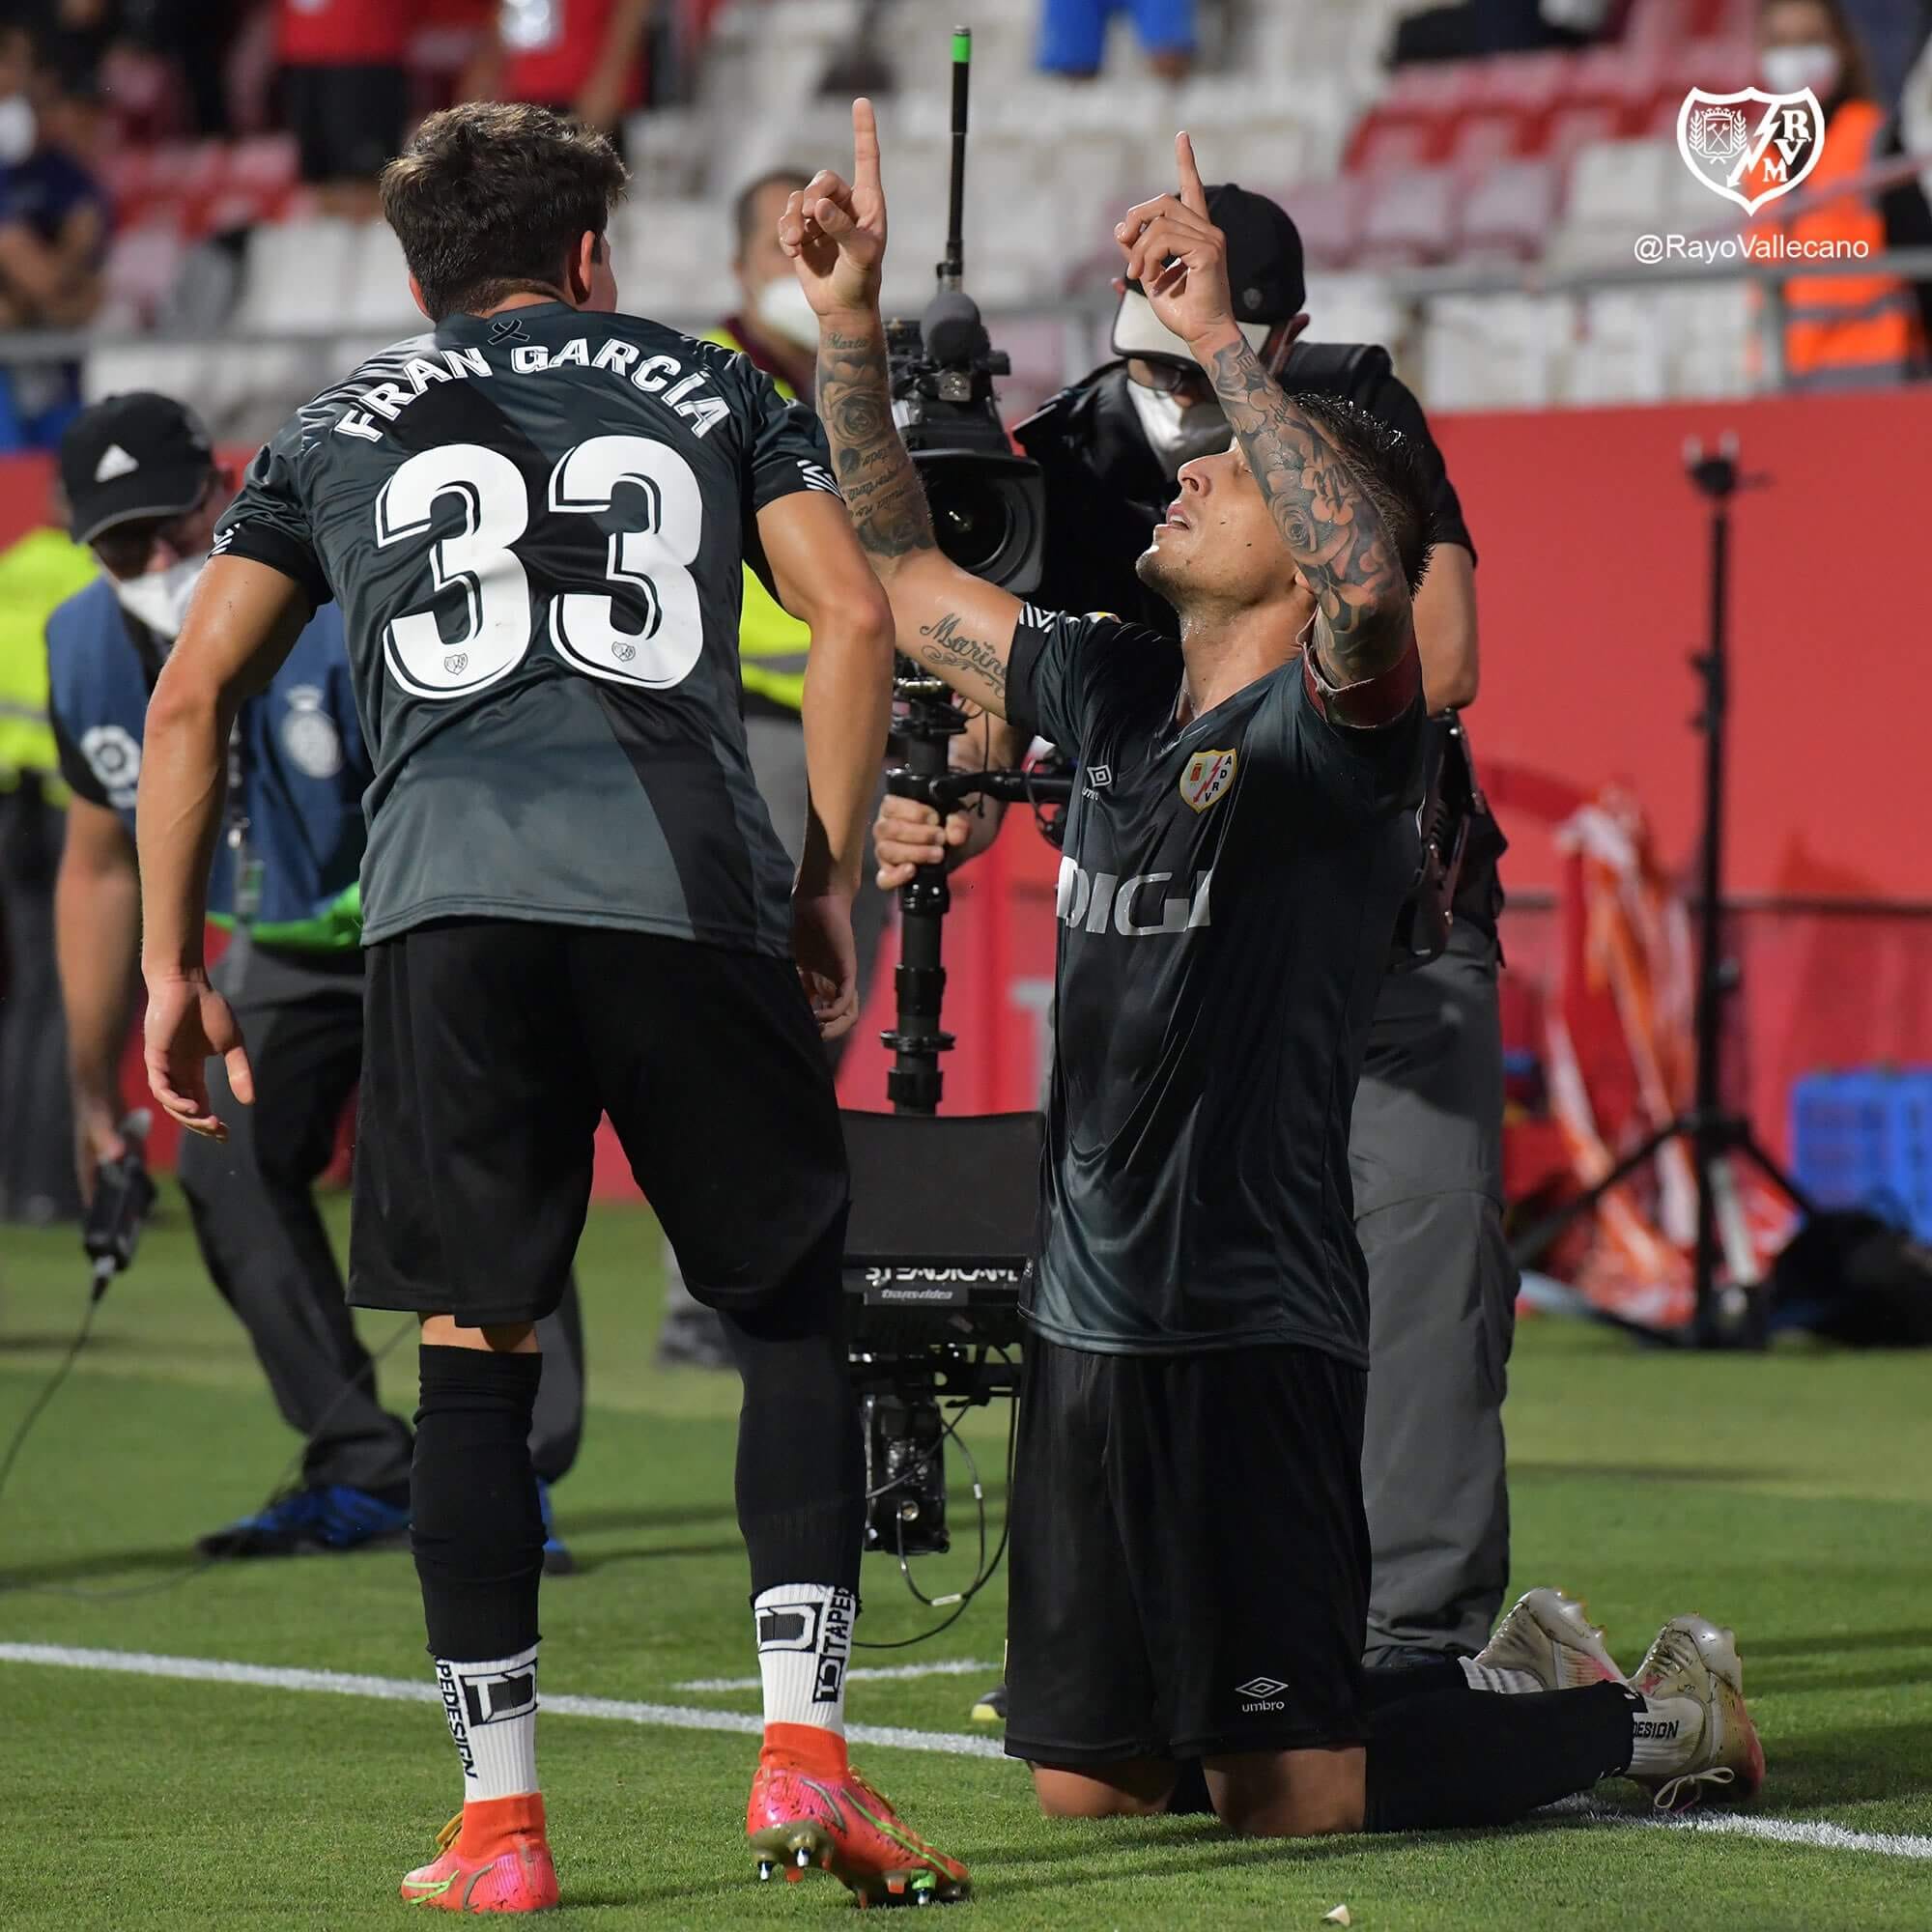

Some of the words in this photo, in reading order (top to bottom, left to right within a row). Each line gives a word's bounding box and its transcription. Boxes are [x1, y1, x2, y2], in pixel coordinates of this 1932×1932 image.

[334, 346, 494, 442] FRAN
[511, 338, 731, 439] GARCÍA
[375, 436, 704, 699] 33
[920, 612, 1006, 678] Marin
[1057, 856, 1211, 936] DIGI
[435, 1657, 478, 1779] PEDESIGN
[1241, 1700, 1285, 1713] umbro
